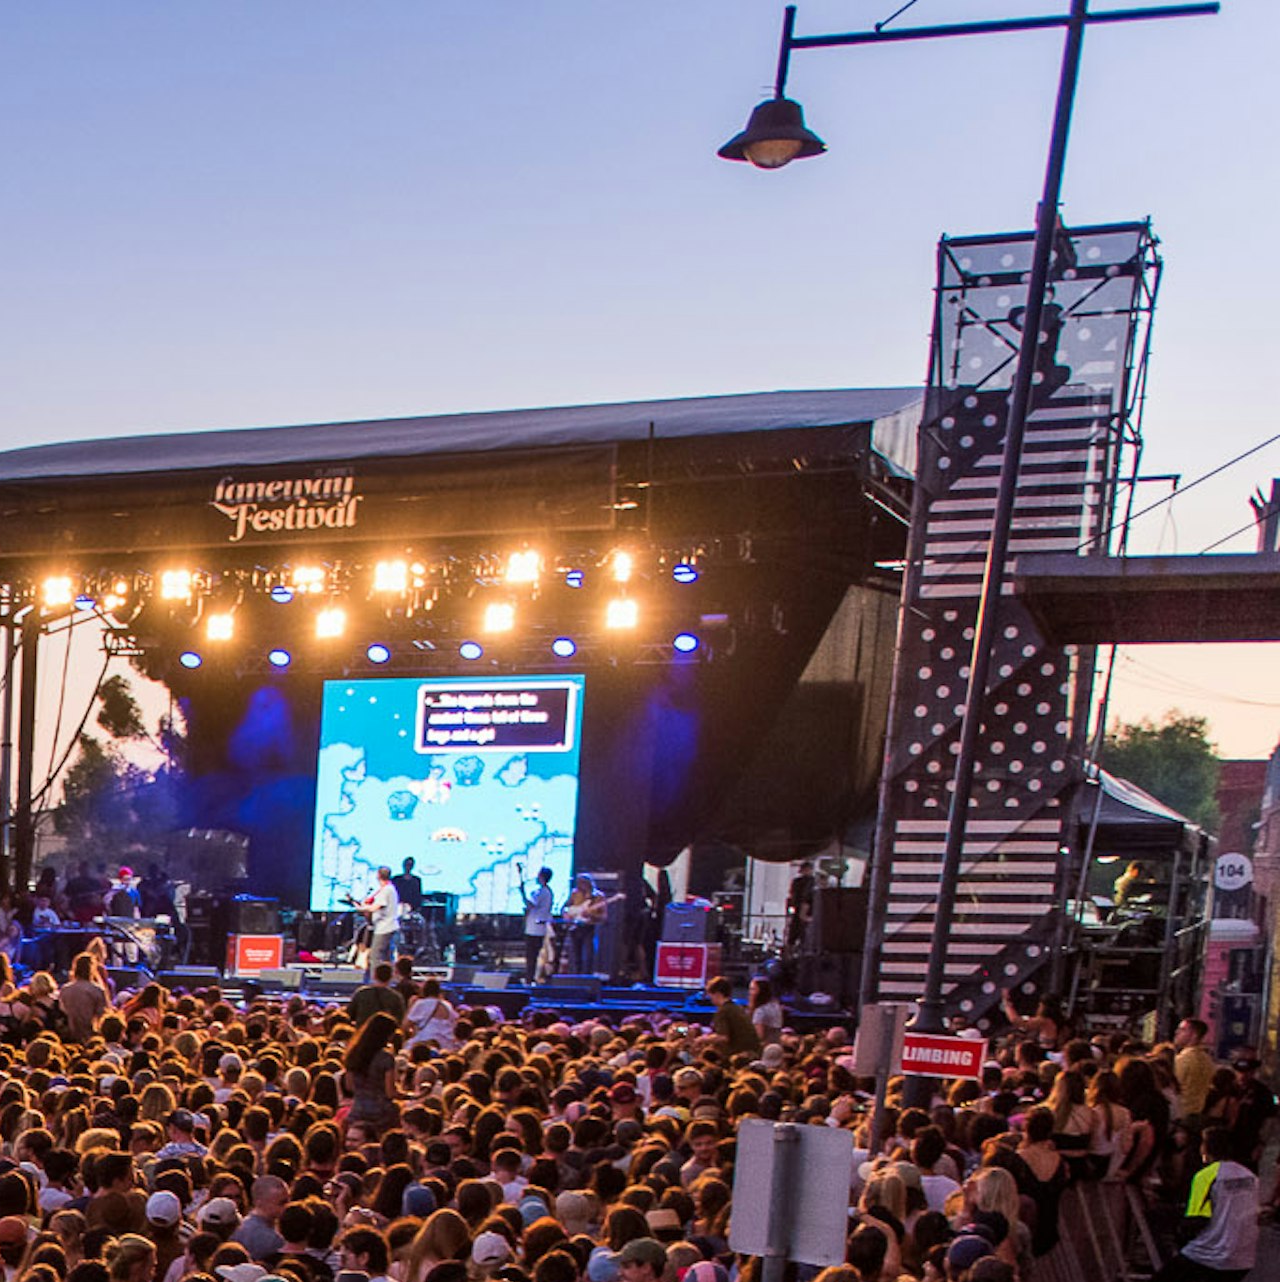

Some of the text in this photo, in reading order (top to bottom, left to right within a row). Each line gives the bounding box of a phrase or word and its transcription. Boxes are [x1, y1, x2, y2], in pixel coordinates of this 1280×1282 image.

[209, 495, 364, 541] Festival
[1219, 863, 1245, 878] 104
[902, 1045, 974, 1067] LIMBING
